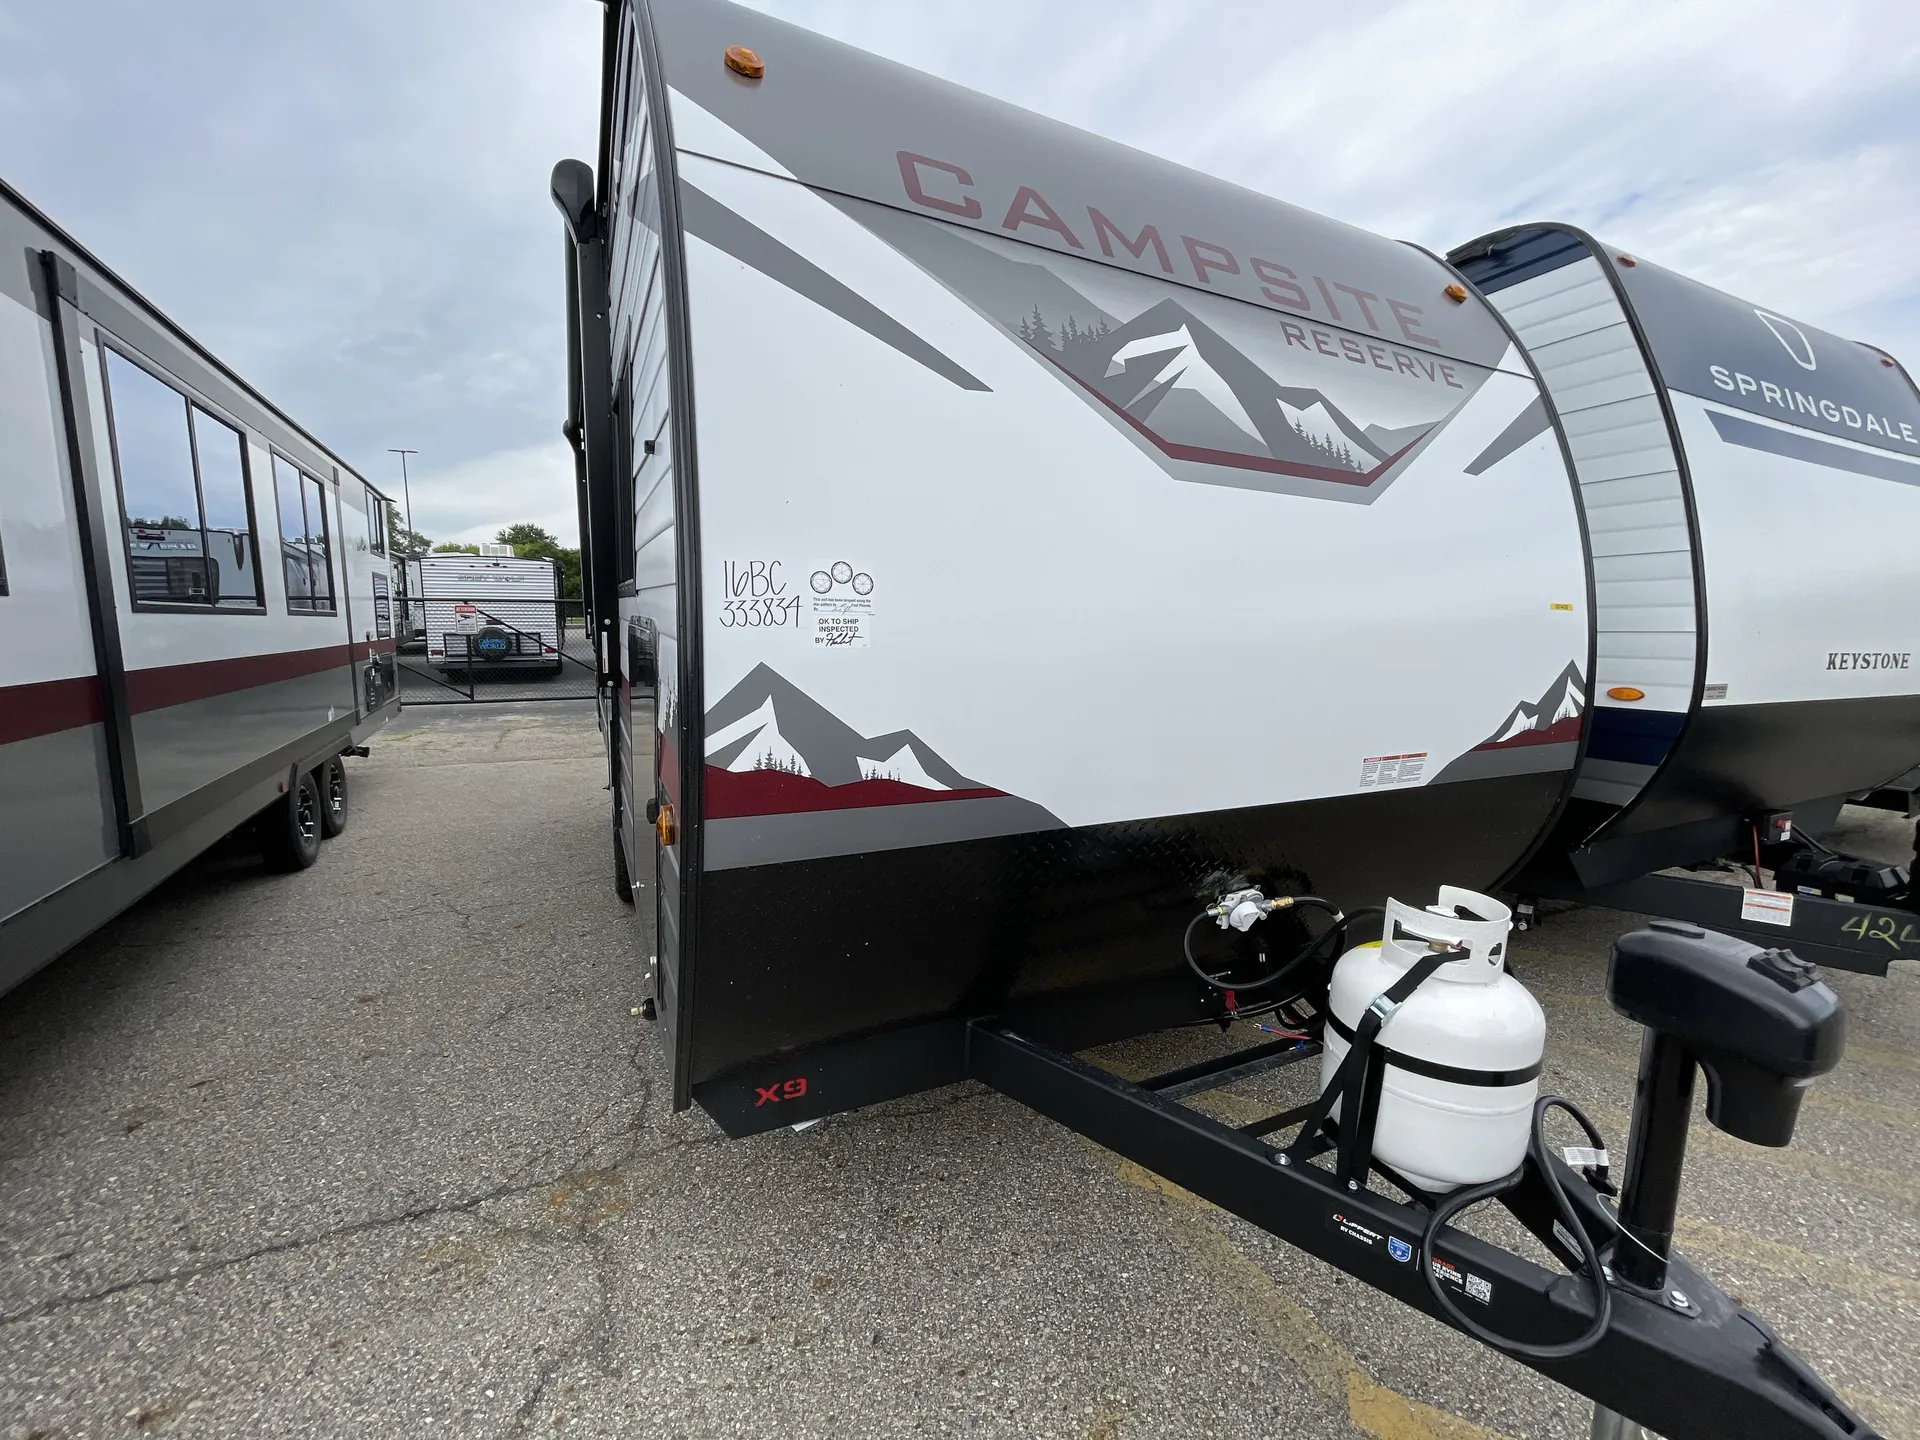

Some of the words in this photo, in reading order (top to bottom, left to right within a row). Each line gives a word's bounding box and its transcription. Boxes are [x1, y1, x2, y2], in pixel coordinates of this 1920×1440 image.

[896, 150, 1441, 349] CAMPSITE
[1279, 321, 1463, 389] RESERVE
[1709, 365, 1919, 443] SPRINGDALE
[724, 560, 787, 599] 16BC
[719, 595, 803, 628] 333834
[1826, 653, 1911, 670] KEYSTONE
[1343, 1218, 1385, 1240] LIPPERT
